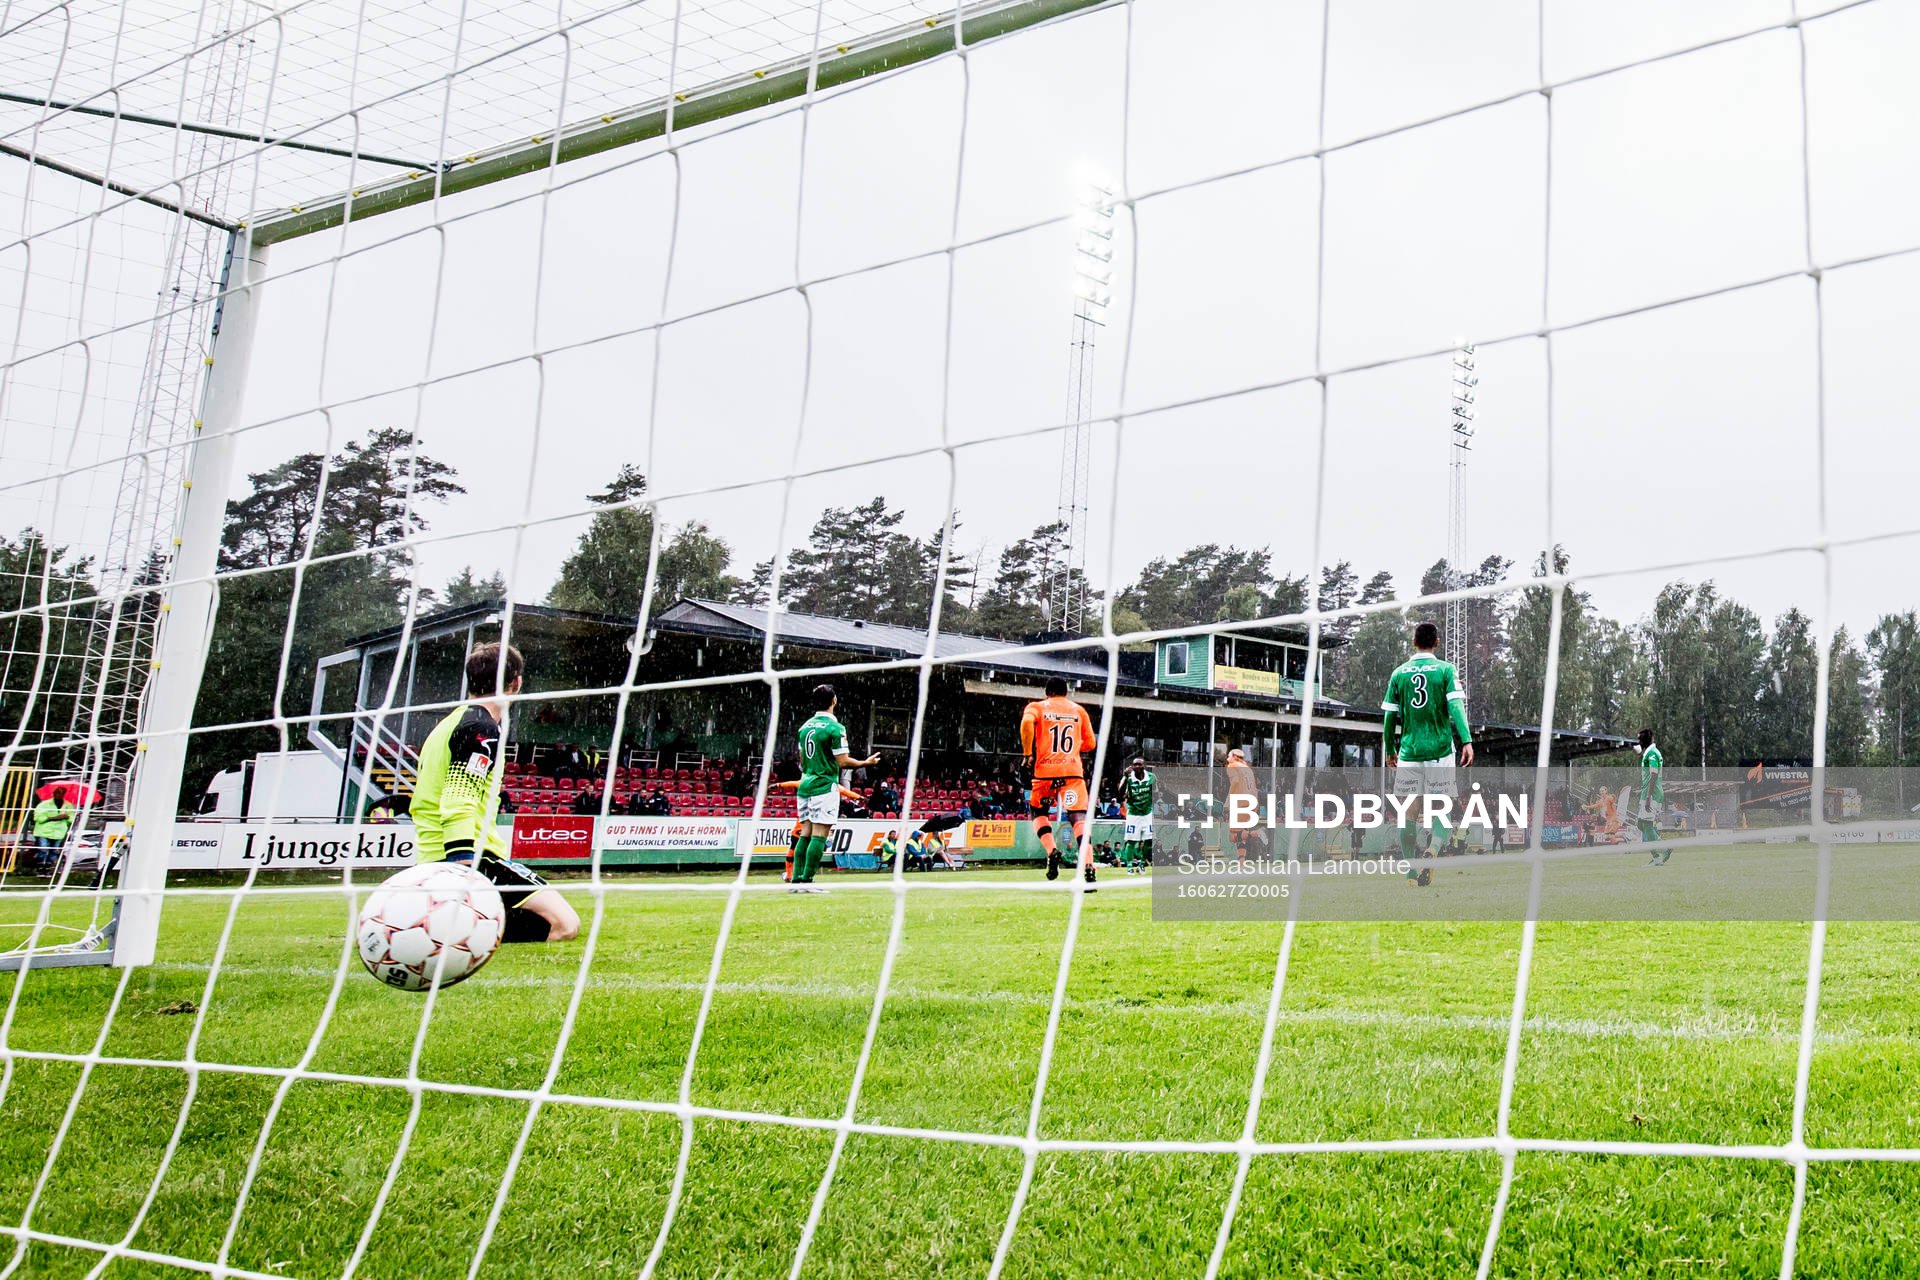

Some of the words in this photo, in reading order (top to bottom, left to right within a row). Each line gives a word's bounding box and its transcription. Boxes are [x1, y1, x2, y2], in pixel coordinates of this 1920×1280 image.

[1410, 673, 1428, 709] 3
[805, 729, 816, 759] 6
[1049, 723, 1074, 754] 16
[1765, 771, 1809, 779] VIVESTRA
[518, 828, 588, 840] utec
[607, 826, 627, 835] GUD
[629, 826, 658, 835] FINNS
[660, 826, 664, 835] I
[667, 826, 695, 835] VARJE
[176, 839, 218, 847] BETONG
[242, 832, 414, 866] Ljungskile
